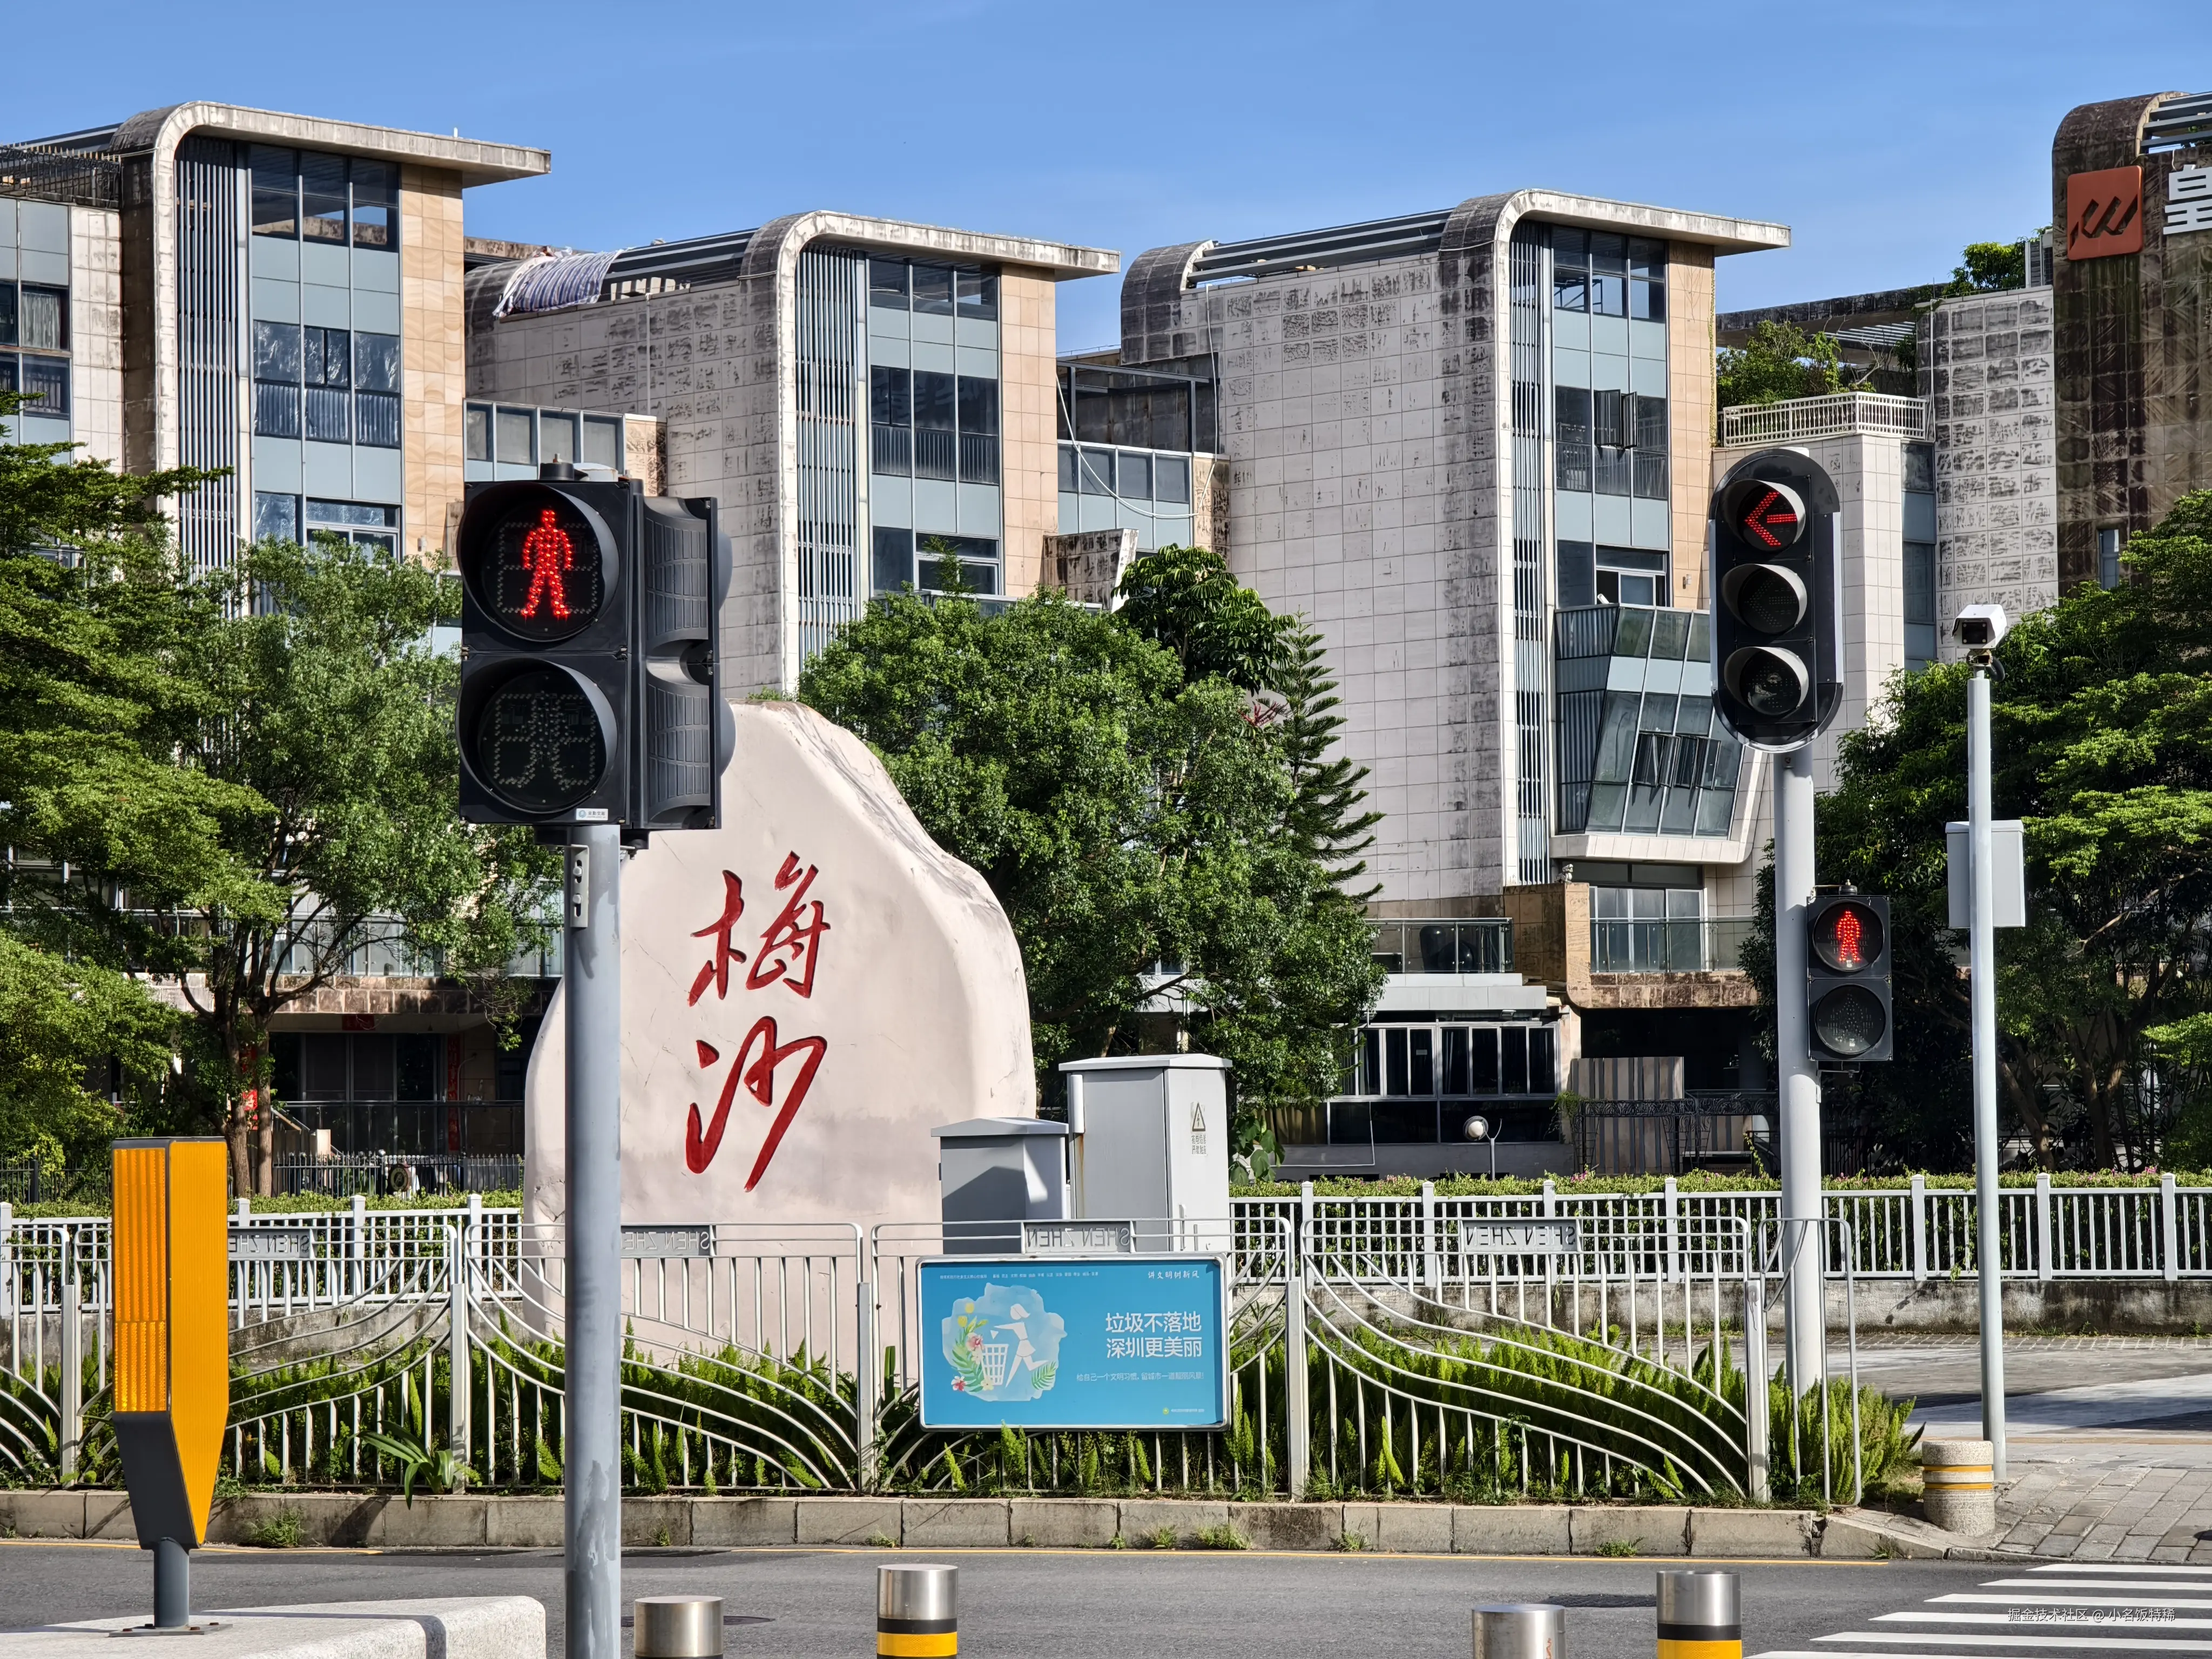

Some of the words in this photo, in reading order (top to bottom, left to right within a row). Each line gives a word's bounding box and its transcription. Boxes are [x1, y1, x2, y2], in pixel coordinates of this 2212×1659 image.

[686, 850, 831, 1192] 梅沙
[1105, 1310, 1202, 1333] 垃圾不落地
[1106, 1336, 1203, 1359] 深圳更美丽
